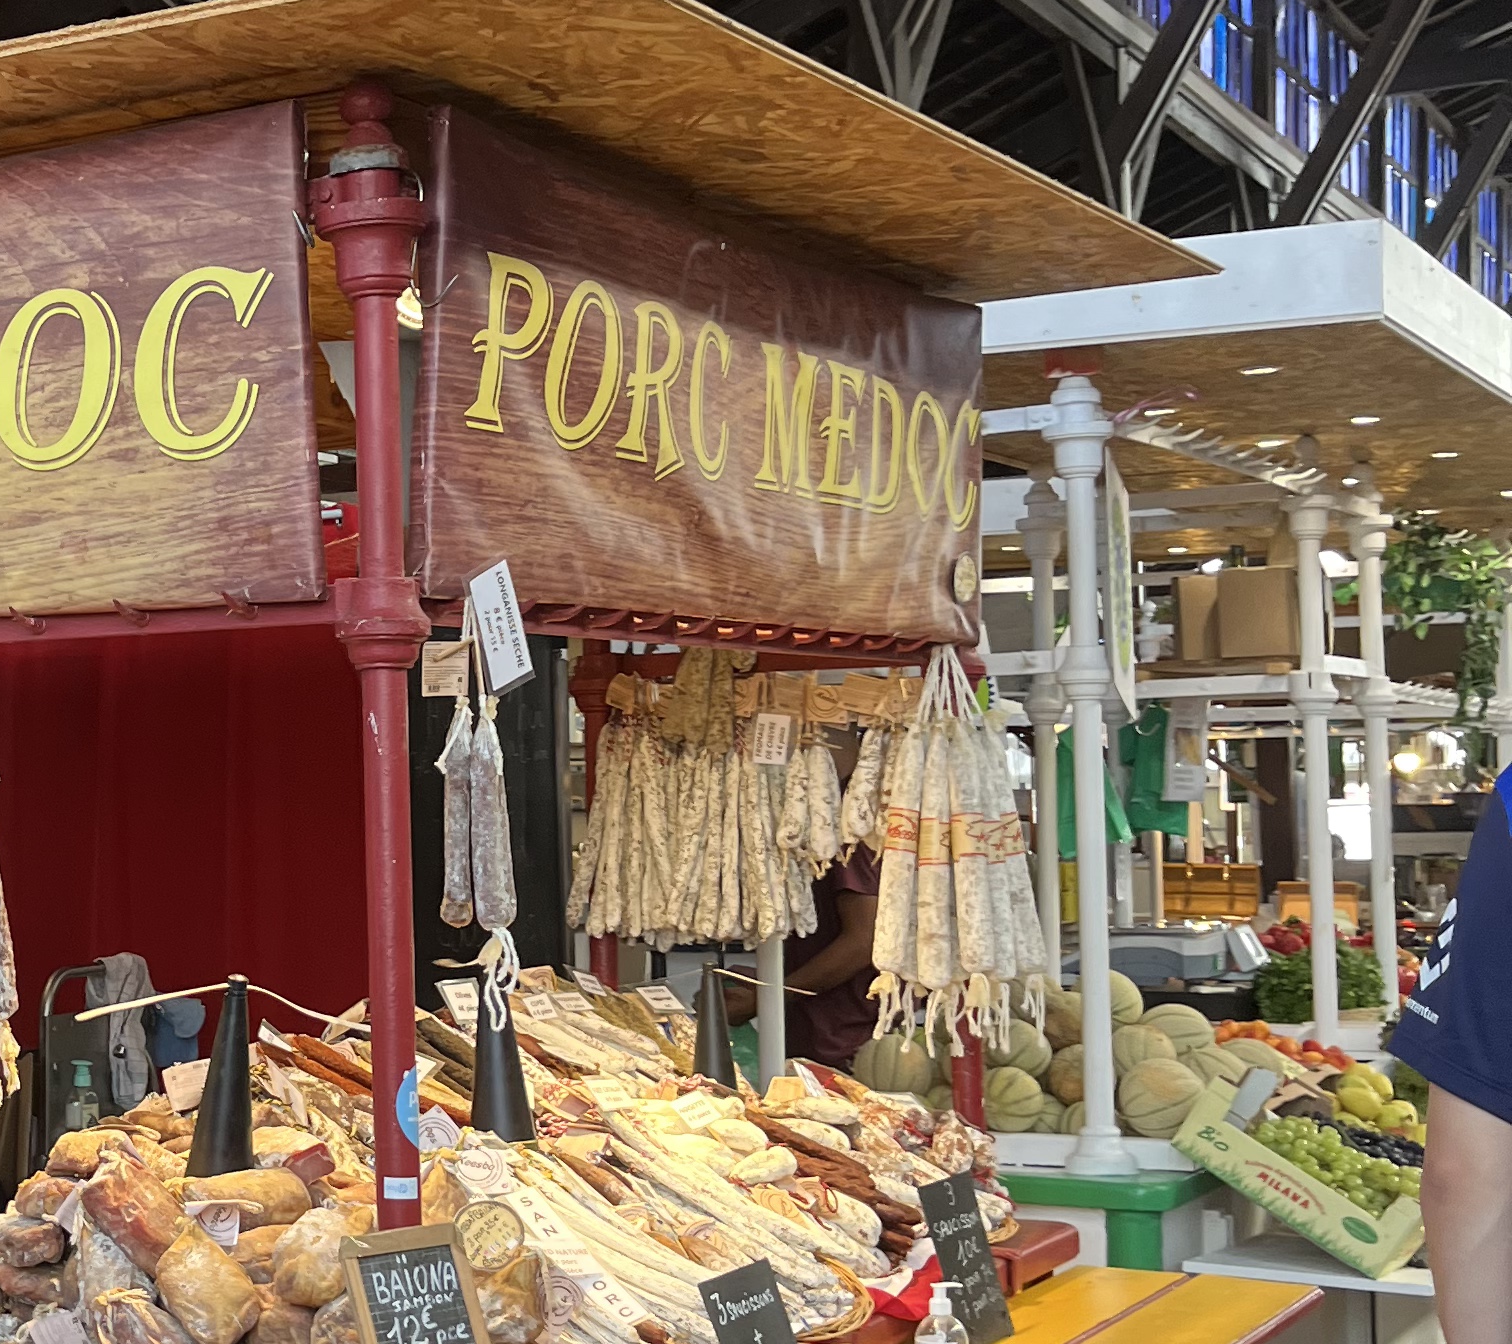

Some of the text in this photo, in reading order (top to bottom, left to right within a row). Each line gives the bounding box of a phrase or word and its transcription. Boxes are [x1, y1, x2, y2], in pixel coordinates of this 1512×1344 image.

[464, 251, 981, 532] PORC MEDOC
[495, 570, 526, 669] LONGANISSE SECHE
[942, 1181, 956, 1206] 3
[392, 1291, 455, 1312] JAMBON
[709, 1292, 728, 1326] 3
